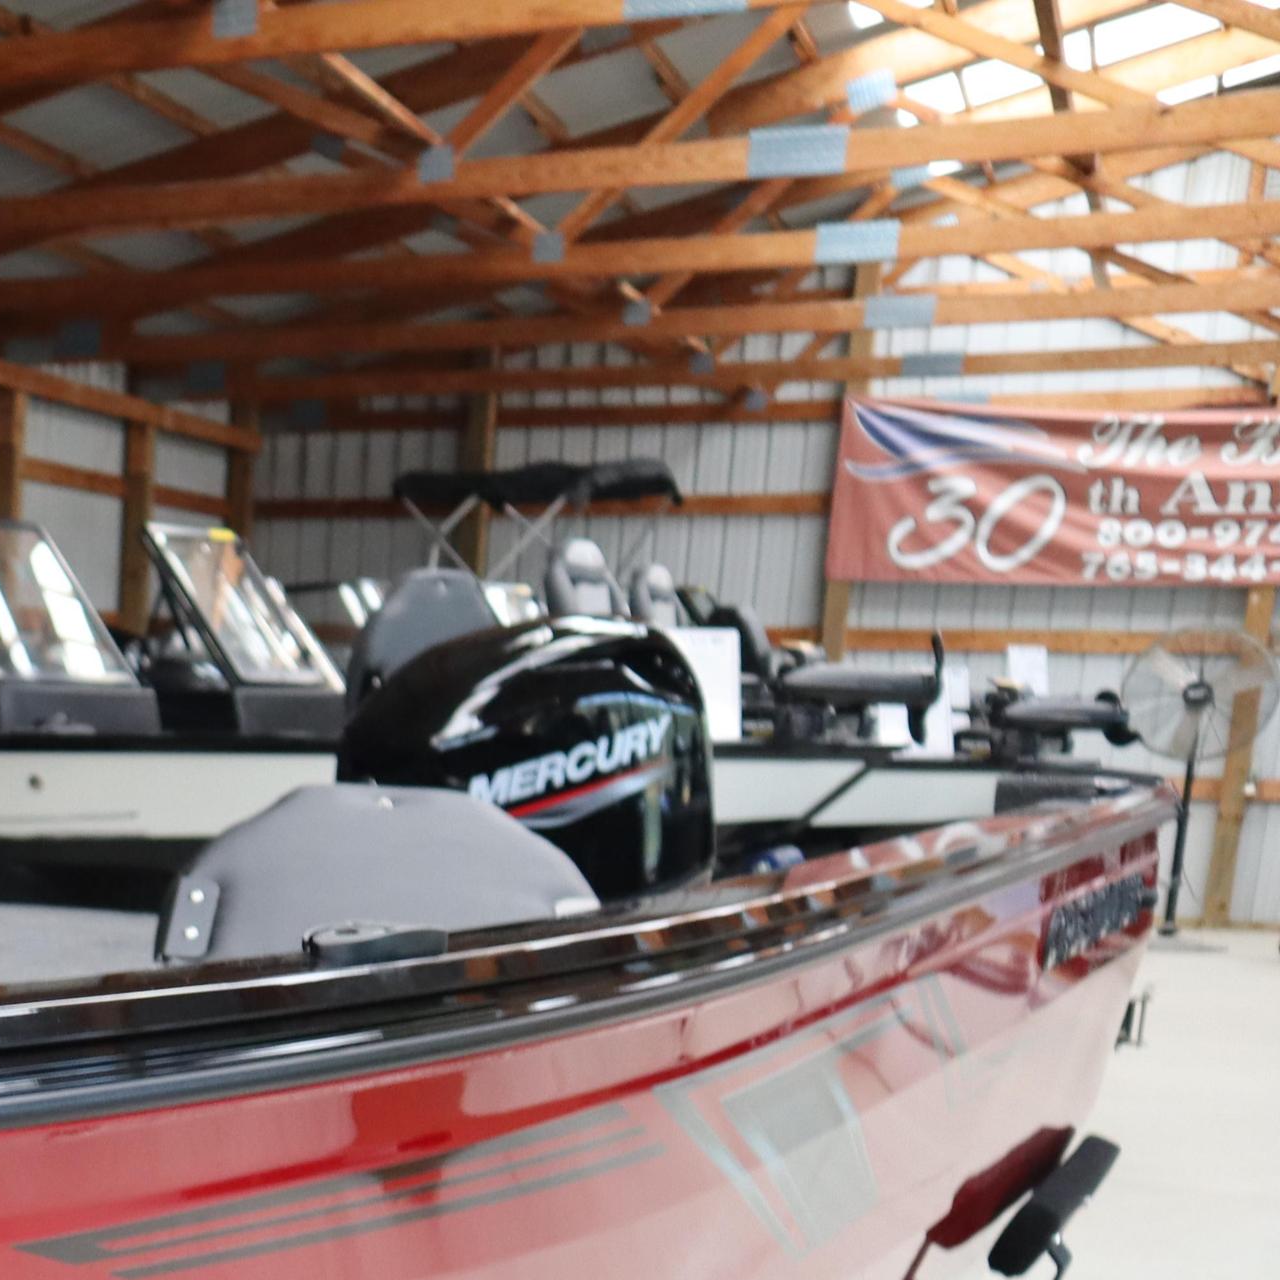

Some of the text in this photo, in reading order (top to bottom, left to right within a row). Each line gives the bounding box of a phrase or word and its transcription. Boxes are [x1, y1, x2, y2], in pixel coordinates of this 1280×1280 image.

[1076, 415, 1202, 470] The
[886, 474, 1067, 572] 30
[1089, 477, 1141, 516] th
[468, 715, 671, 803] MERCURY
